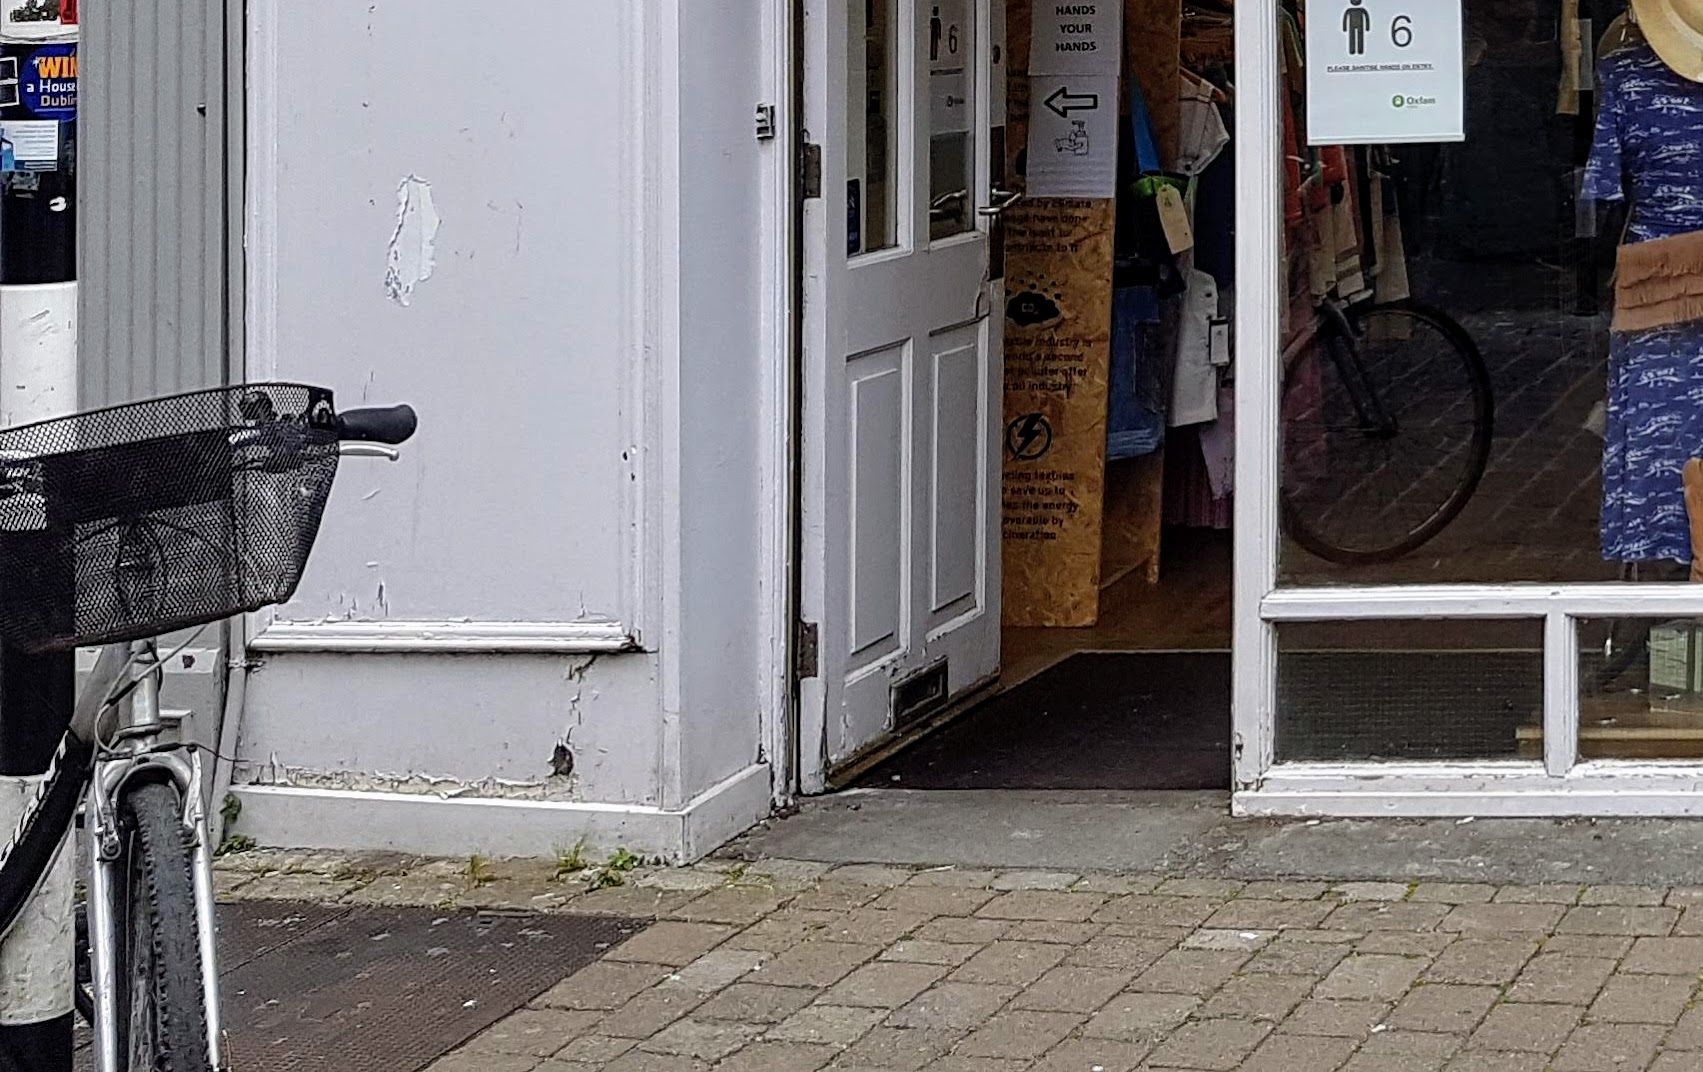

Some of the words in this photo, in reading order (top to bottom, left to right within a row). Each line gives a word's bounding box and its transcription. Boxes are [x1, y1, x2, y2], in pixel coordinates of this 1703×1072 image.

[1055, 5, 1096, 15] HANDS
[1060, 23, 1092, 34] YOUR
[1391, 15, 1413, 48] 6
[948, 24, 958, 54] 6
[1055, 41, 1097, 51] HANDS
[27, 83, 34, 93] a
[1406, 96, 1436, 105] Oxfam
